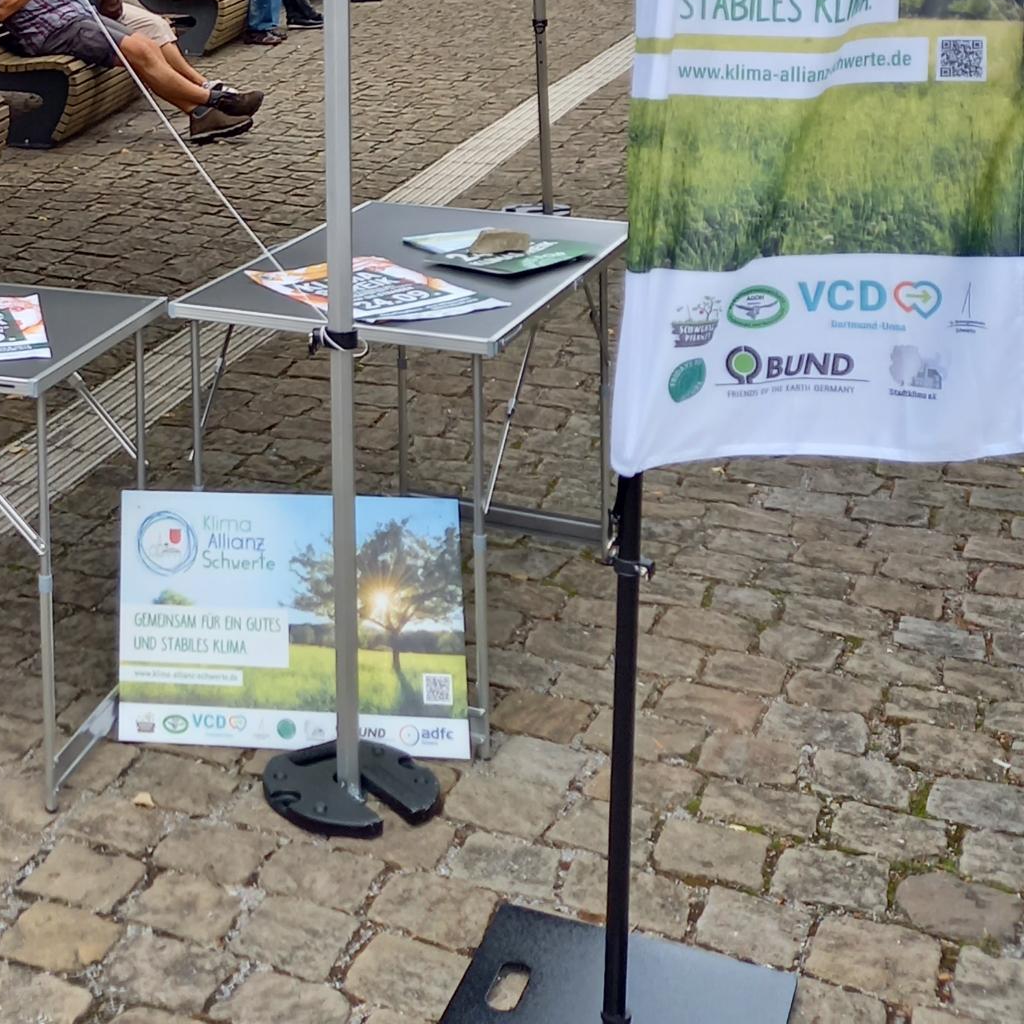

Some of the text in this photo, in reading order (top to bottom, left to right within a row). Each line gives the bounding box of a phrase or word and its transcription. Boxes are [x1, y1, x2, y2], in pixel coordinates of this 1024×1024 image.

[354, 289, 440, 310] 24.09.
[798, 280, 887, 312] VCD
[766, 352, 855, 379] BUND
[814, 384, 855, 394] GERMANY
[203, 515, 252, 533] Klima
[207, 532, 266, 552] Allianz
[202, 549, 276, 571] Schwerte
[134, 612, 282, 633] GEMEINSAM FÜR EIN GUTES
[133, 636, 247, 655] UND STABILES KLIMA
[192, 713, 227, 729] VCD
[358, 727, 387, 739] UND
[421, 727, 454, 740] adfc
